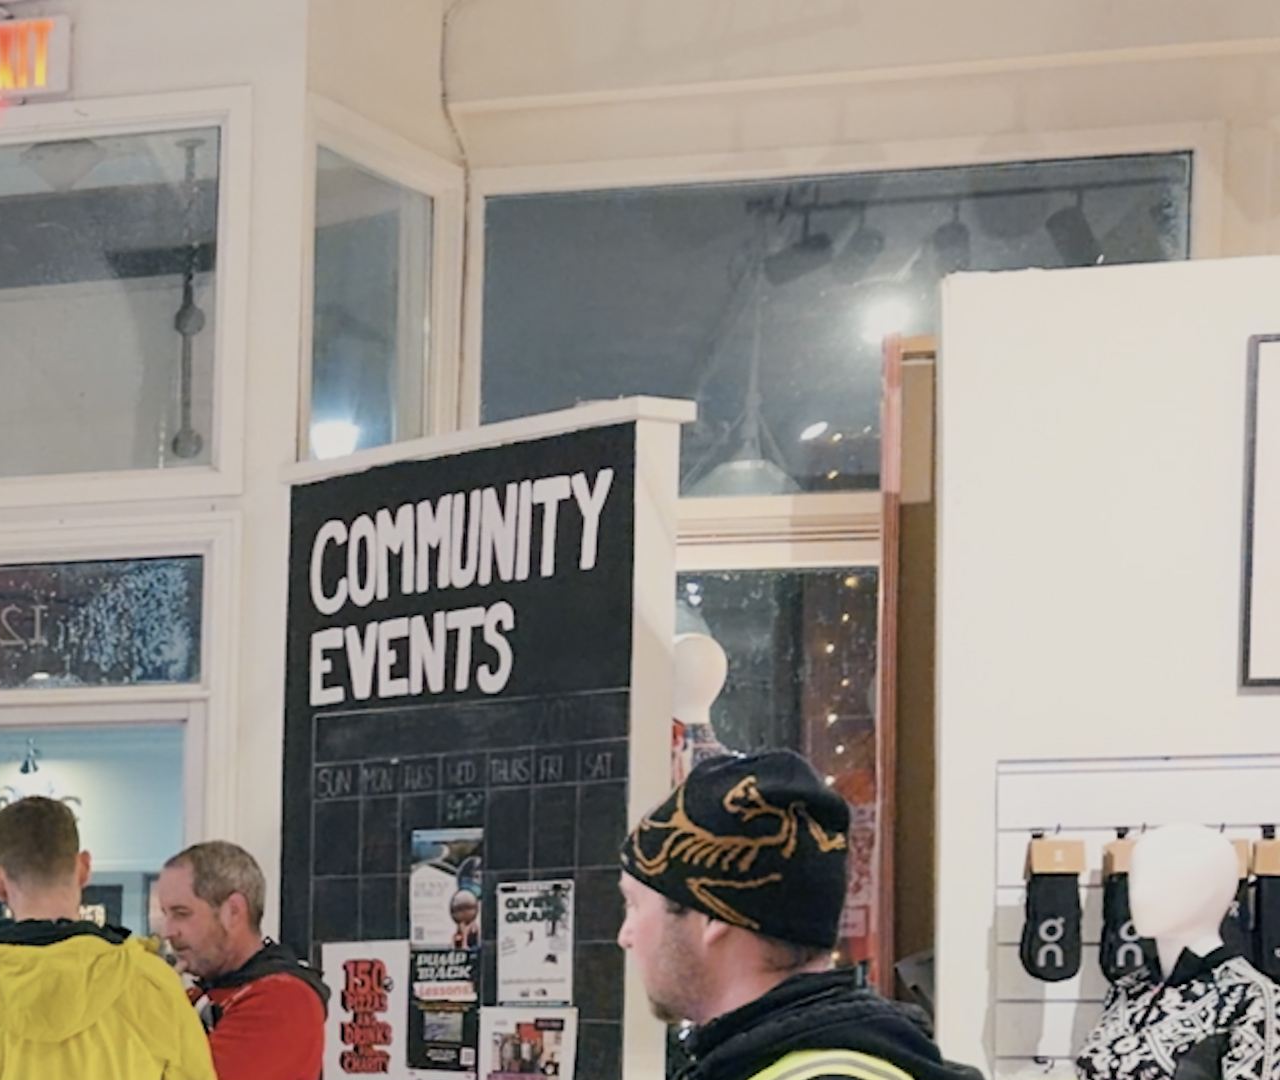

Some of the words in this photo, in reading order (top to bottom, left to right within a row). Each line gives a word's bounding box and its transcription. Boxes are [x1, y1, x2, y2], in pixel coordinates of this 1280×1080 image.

[309, 467, 614, 615] COMMUNITY
[308, 600, 516, 707] EVENTS
[317, 767, 352, 797] SUN
[364, 768, 393, 792] MON
[490, 756, 529, 783] THURS
[585, 752, 613, 778] SAT
[343, 959, 387, 993] 150
[417, 964, 473, 980] TRACK
[342, 1022, 392, 1045] DRINKS
[341, 1051, 390, 1074] CHARITY
